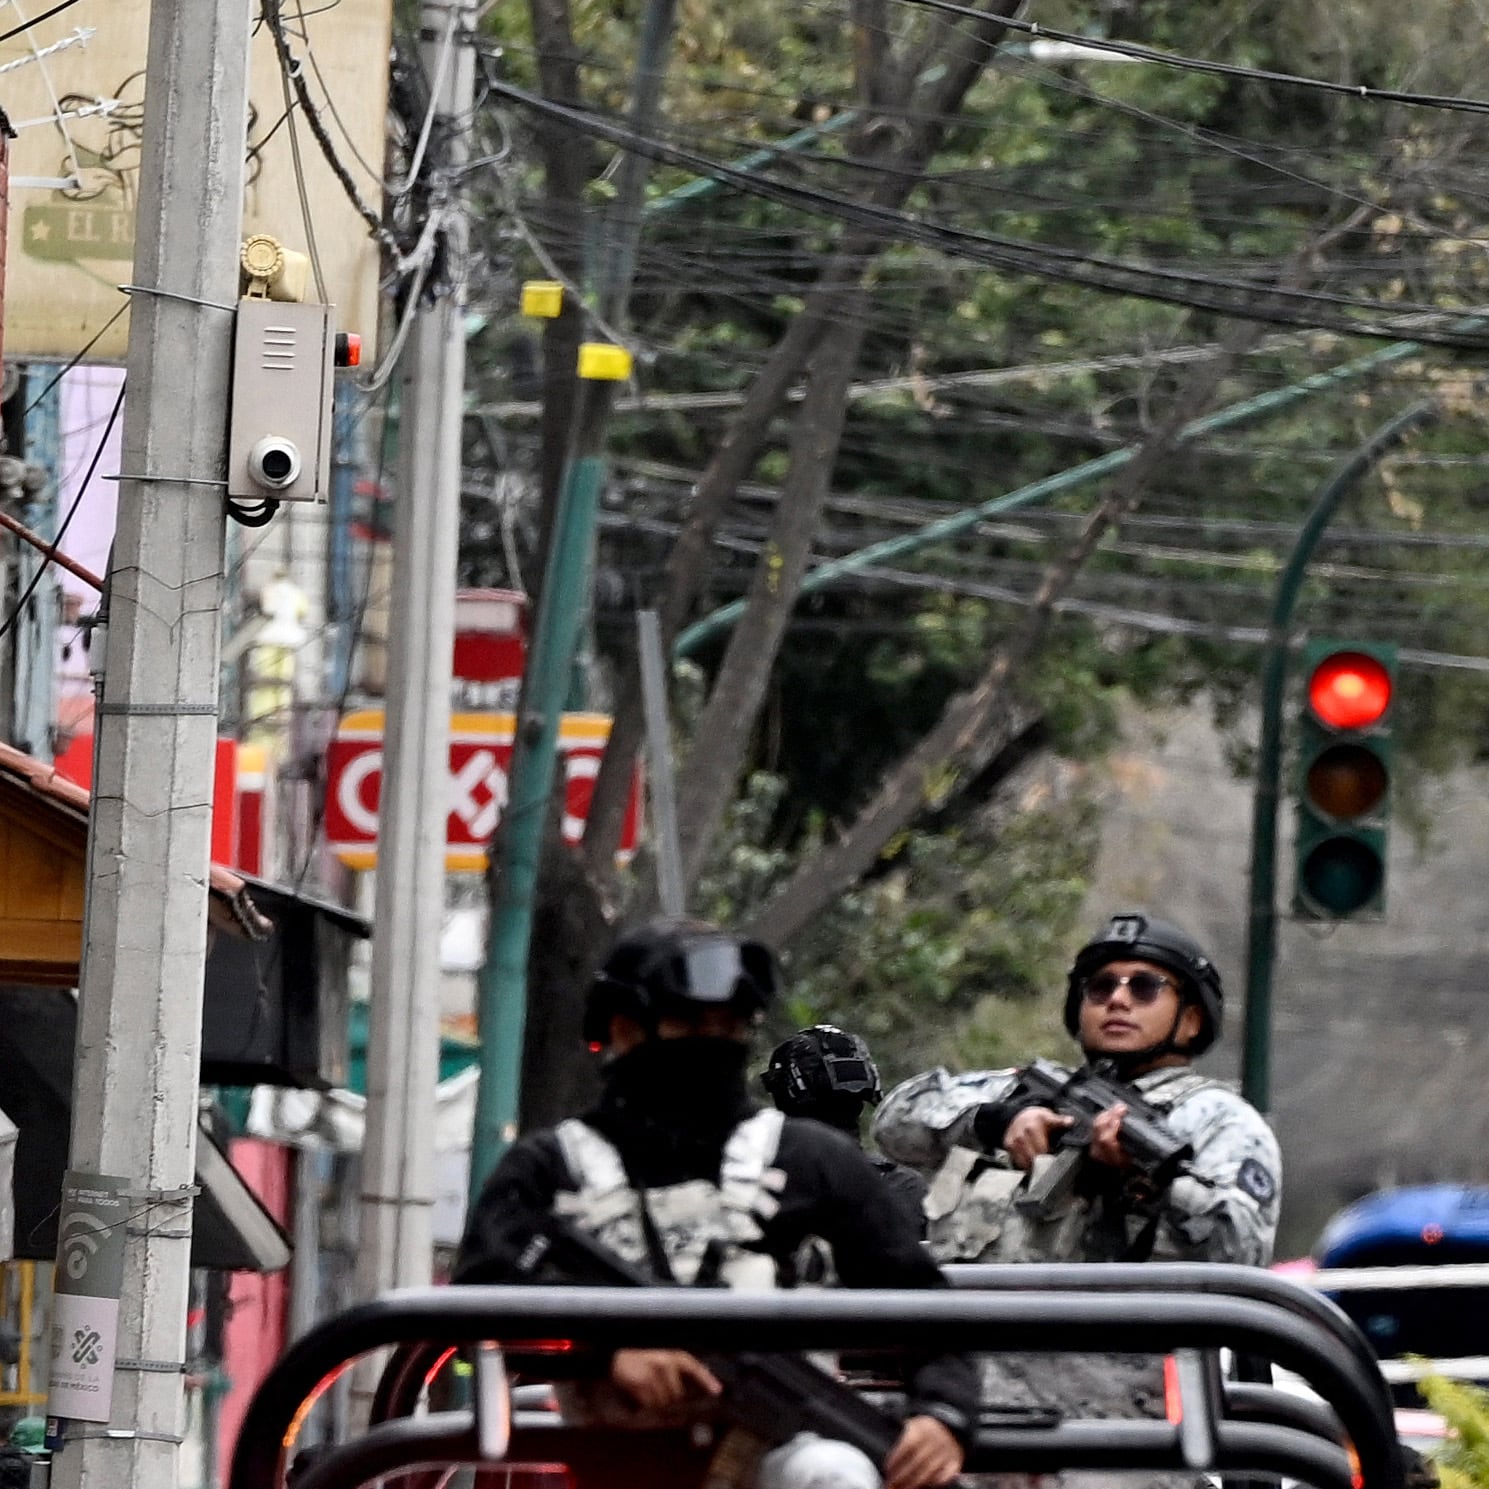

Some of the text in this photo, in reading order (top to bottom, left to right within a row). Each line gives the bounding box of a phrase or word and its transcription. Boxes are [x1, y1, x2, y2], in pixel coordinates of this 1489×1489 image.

[67, 210, 101, 241] EL
[337, 750, 600, 841] OX
[95, 1198, 120, 1207] TODOS
